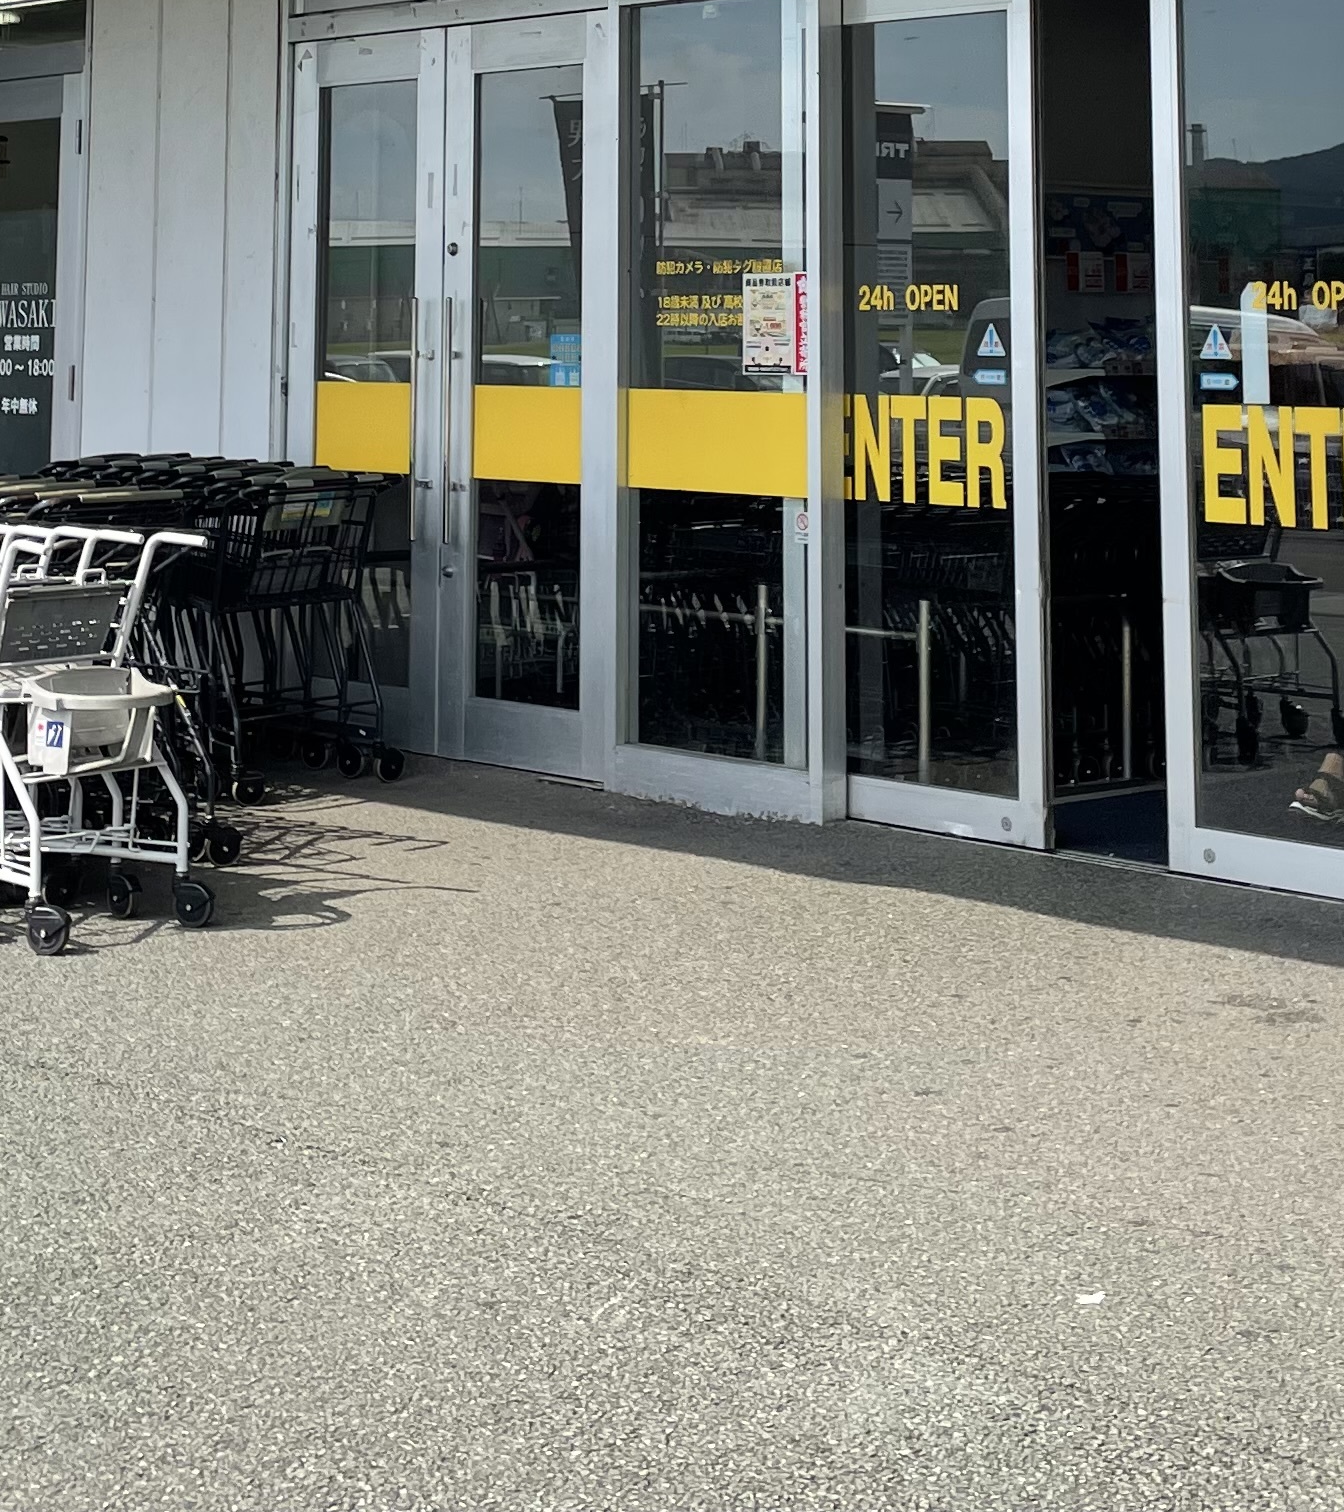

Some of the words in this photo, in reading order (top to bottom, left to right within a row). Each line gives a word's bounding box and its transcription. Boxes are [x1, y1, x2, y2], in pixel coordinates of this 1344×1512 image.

[1, 283, 19, 296] HAIR
[21, 282, 49, 296] STUDIO
[858, 285, 895, 311] 24h
[905, 284, 959, 311] OPEN
[1252, 281, 1298, 311] 24h
[27, 358, 55, 377] 18:00
